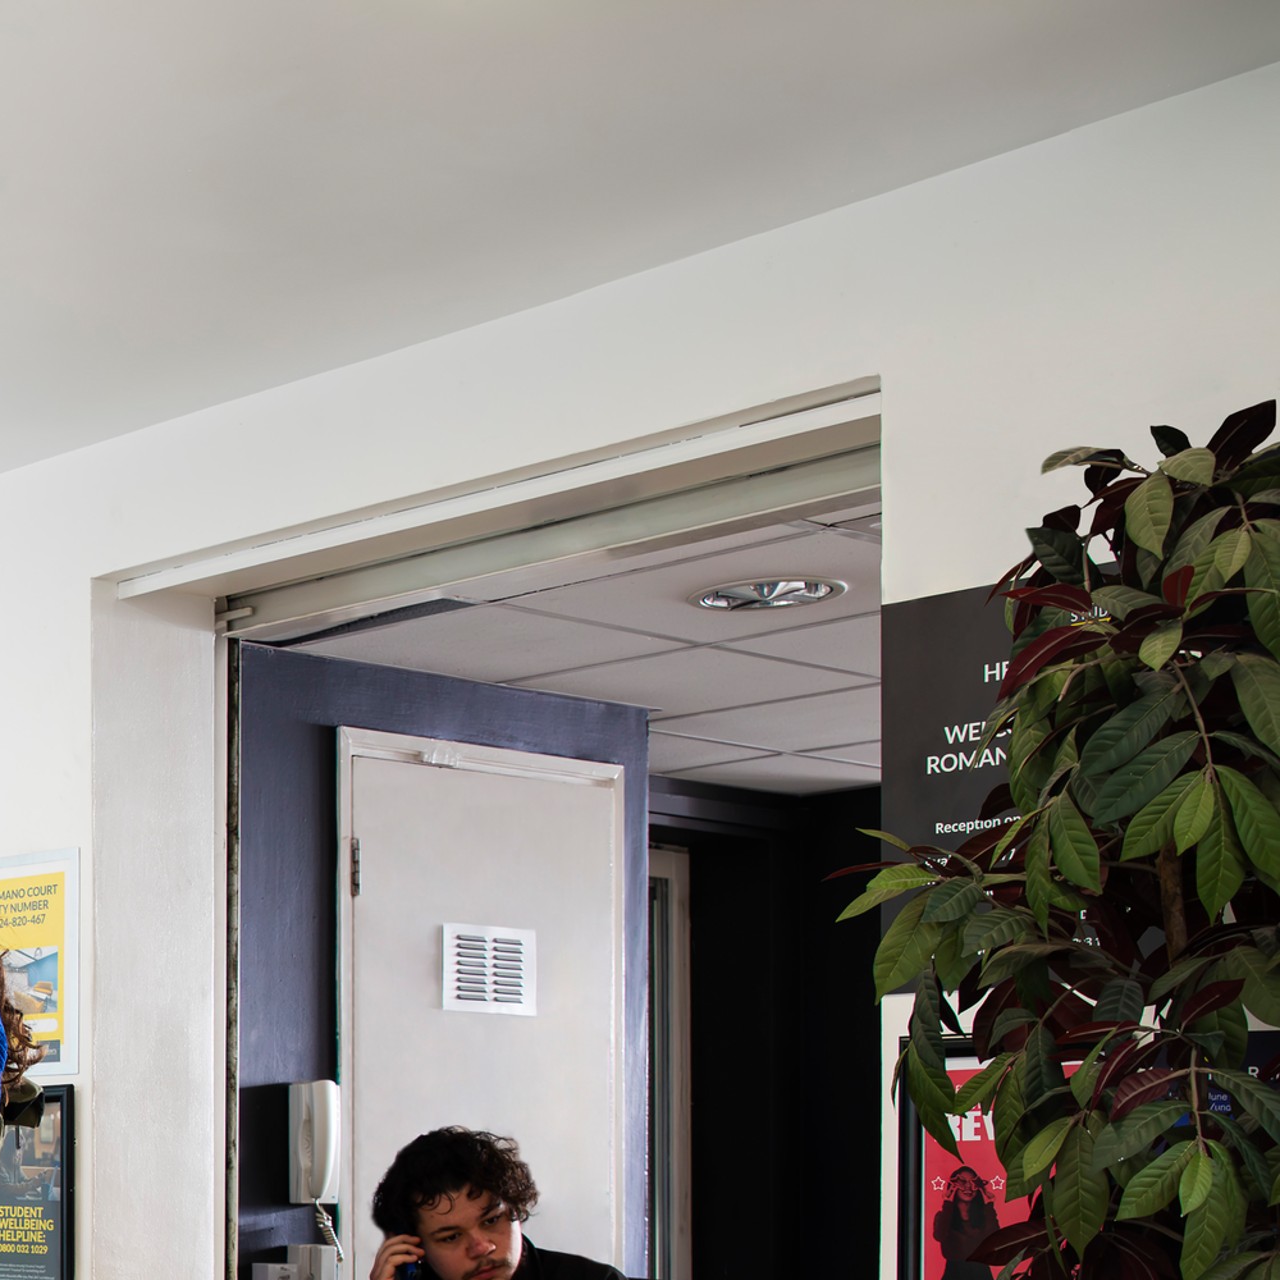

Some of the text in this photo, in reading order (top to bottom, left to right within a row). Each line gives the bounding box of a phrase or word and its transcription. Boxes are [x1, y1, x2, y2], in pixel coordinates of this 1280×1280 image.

[935, 818, 1001, 834] Reception
[27, 884, 58, 897] COURT
[10, 899, 49, 912] NUMBER
[16, 1244, 30, 1253] 032
[31, 1245, 48, 1254] 1029
